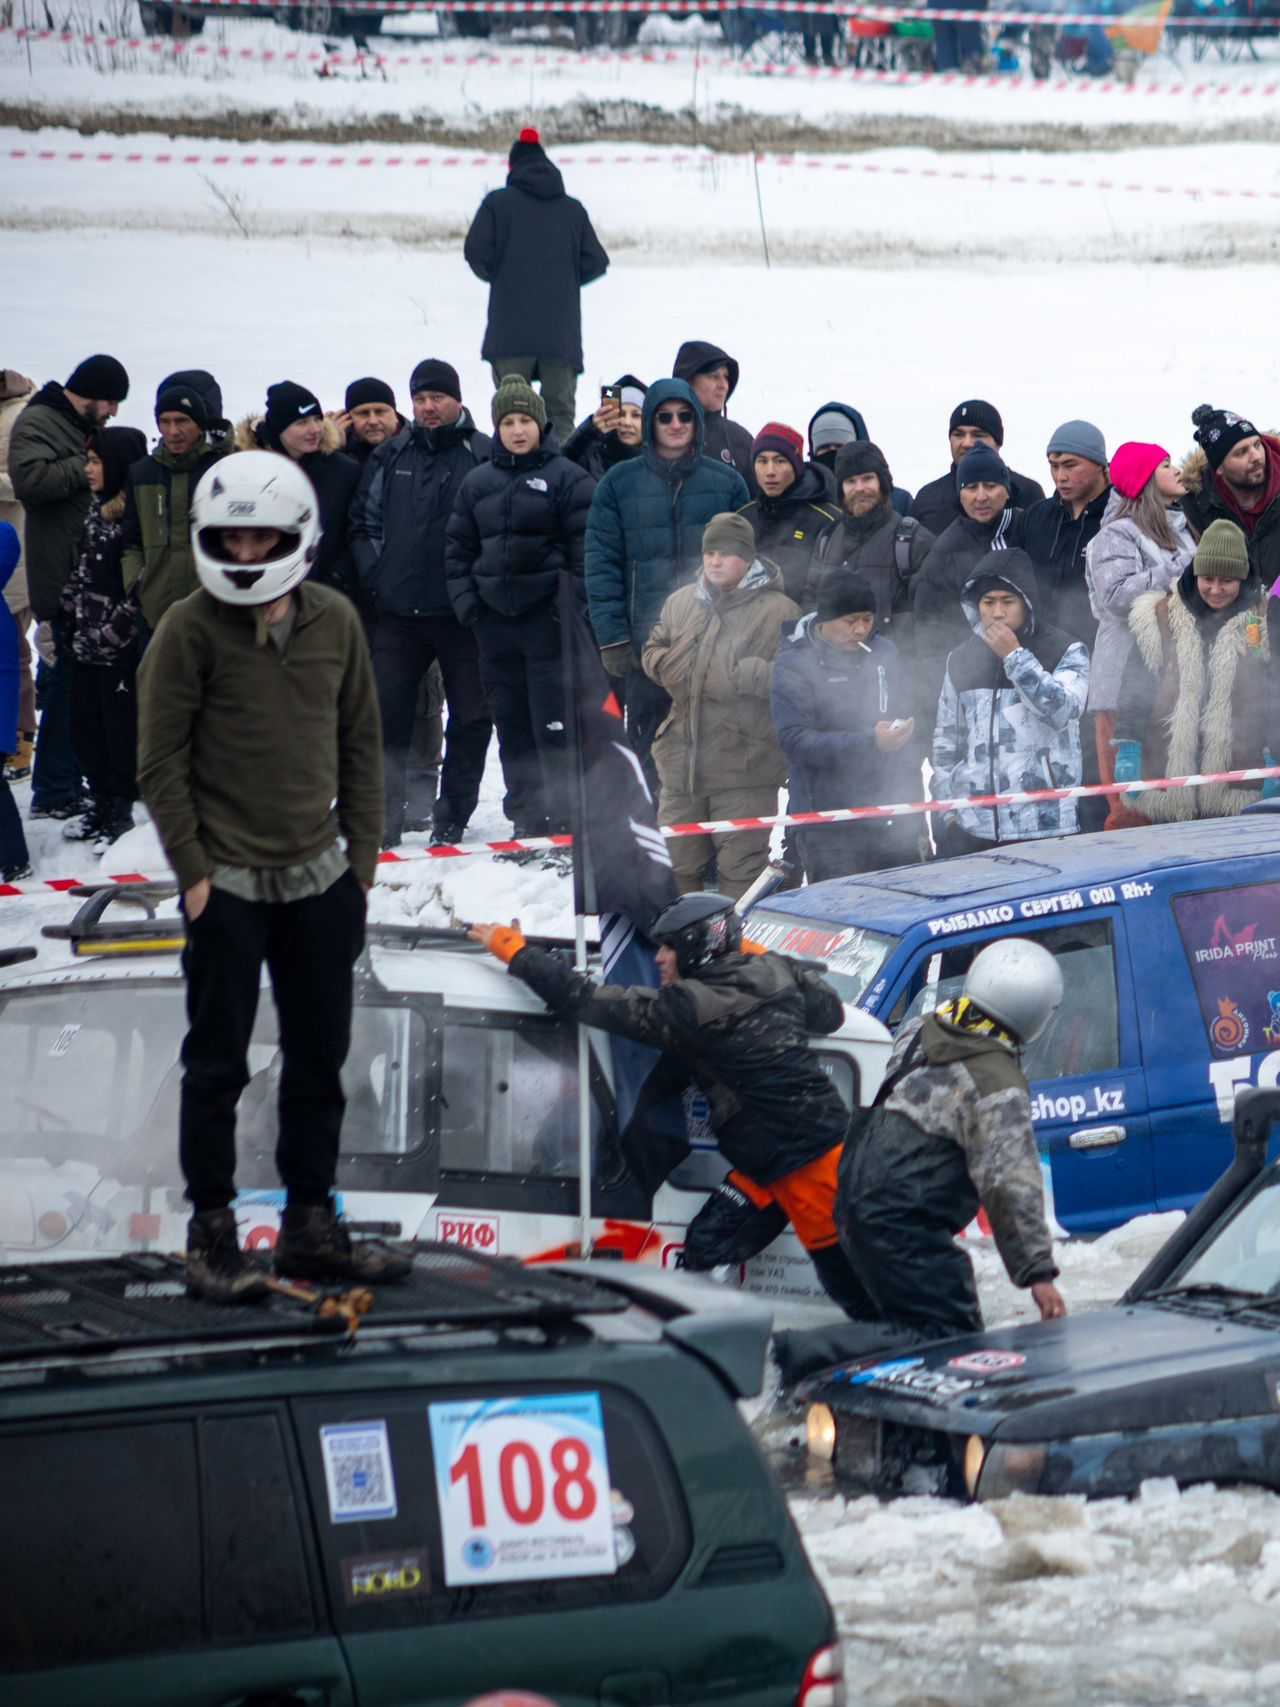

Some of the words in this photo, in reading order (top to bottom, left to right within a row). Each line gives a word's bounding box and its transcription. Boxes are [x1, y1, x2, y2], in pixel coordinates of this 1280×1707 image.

[928, 905, 1014, 935] РЫБАЛКО
[1020, 890, 1083, 918] СЕРГЕЙ
[1121, 881, 1154, 900] Rh+
[777, 926, 845, 957] FAMILY
[1195, 945, 1234, 962] IRIDA
[1235, 937, 1276, 956] PRINT
[1251, 947, 1279, 961] Plus
[440, 1220, 495, 1248] РИФ
[450, 1436, 597, 1528] 108
